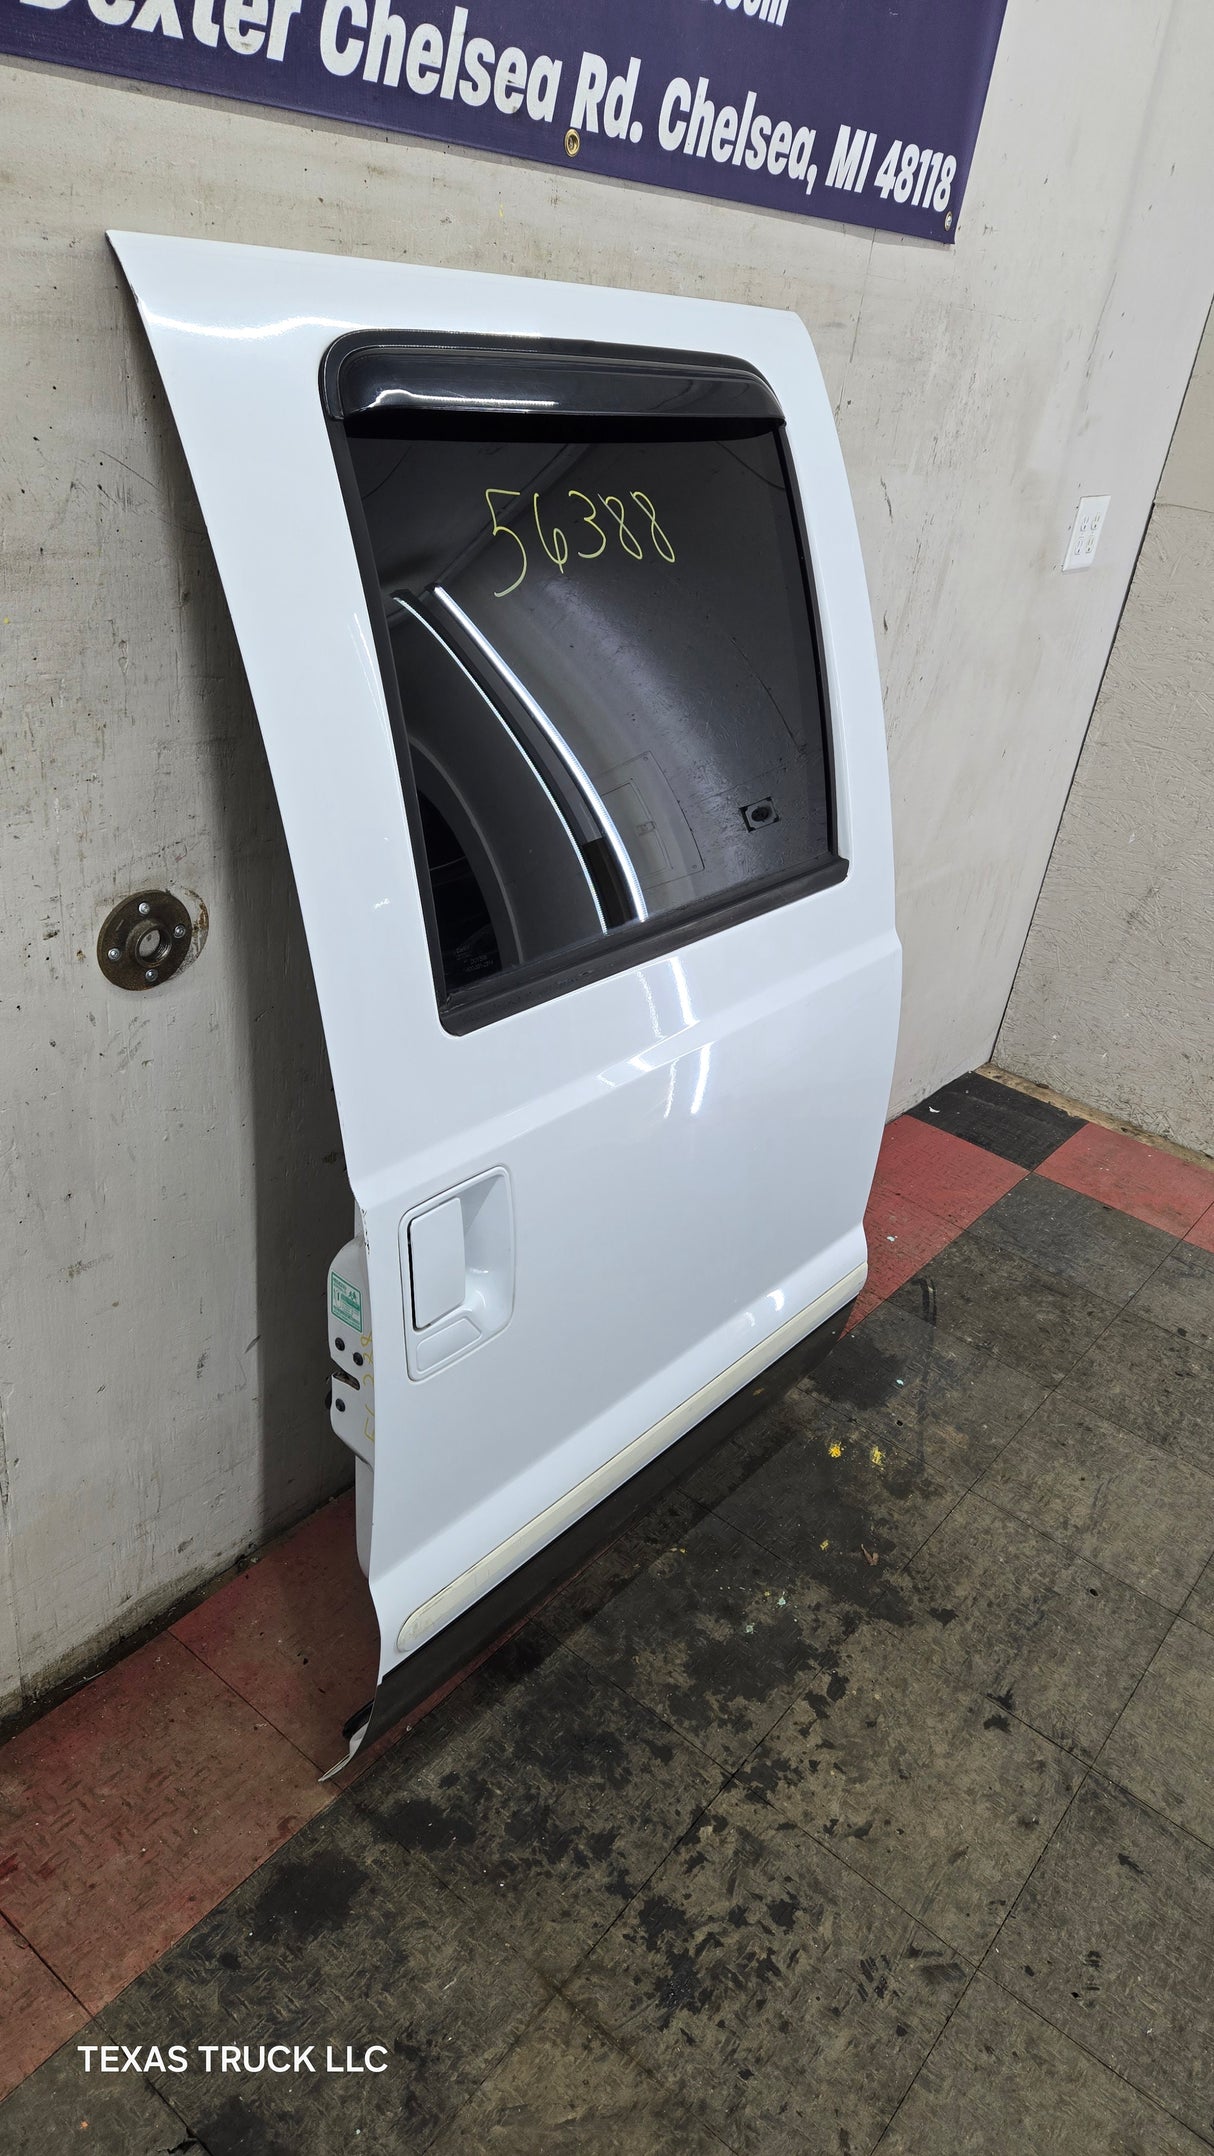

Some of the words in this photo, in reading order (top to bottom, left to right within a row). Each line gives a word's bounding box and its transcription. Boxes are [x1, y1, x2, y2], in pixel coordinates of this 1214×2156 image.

[319, 0, 563, 123] Chelsea
[569, 51, 643, 145] Rd.
[658, 77, 818, 196] Chelsea,
[824, 125, 878, 194] MI
[879, 139, 957, 213] 48118
[485, 487, 676, 598] 56388
